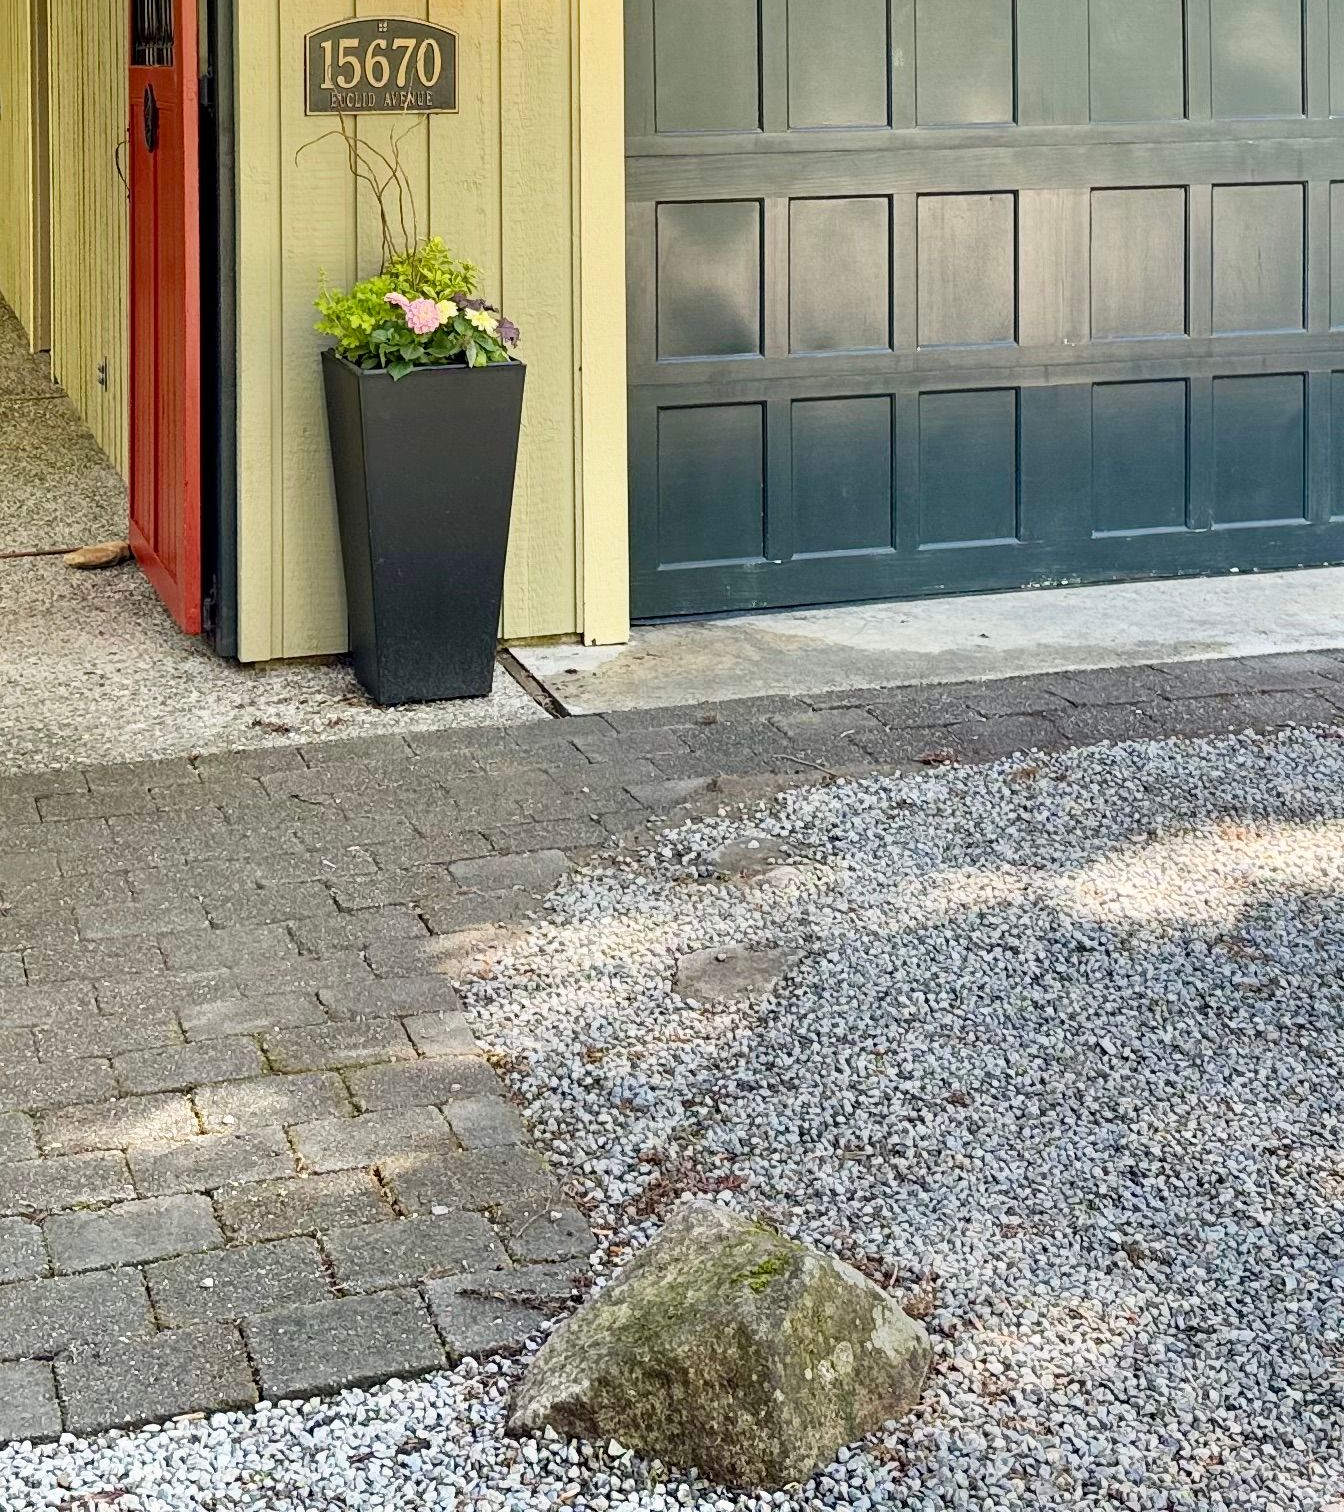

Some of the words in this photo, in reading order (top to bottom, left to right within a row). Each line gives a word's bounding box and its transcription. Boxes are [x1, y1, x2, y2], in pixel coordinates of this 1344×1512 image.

[320, 38, 442, 89] 15670
[330, 92, 376, 108] EUCLID
[384, 91, 433, 107] AVENUE
